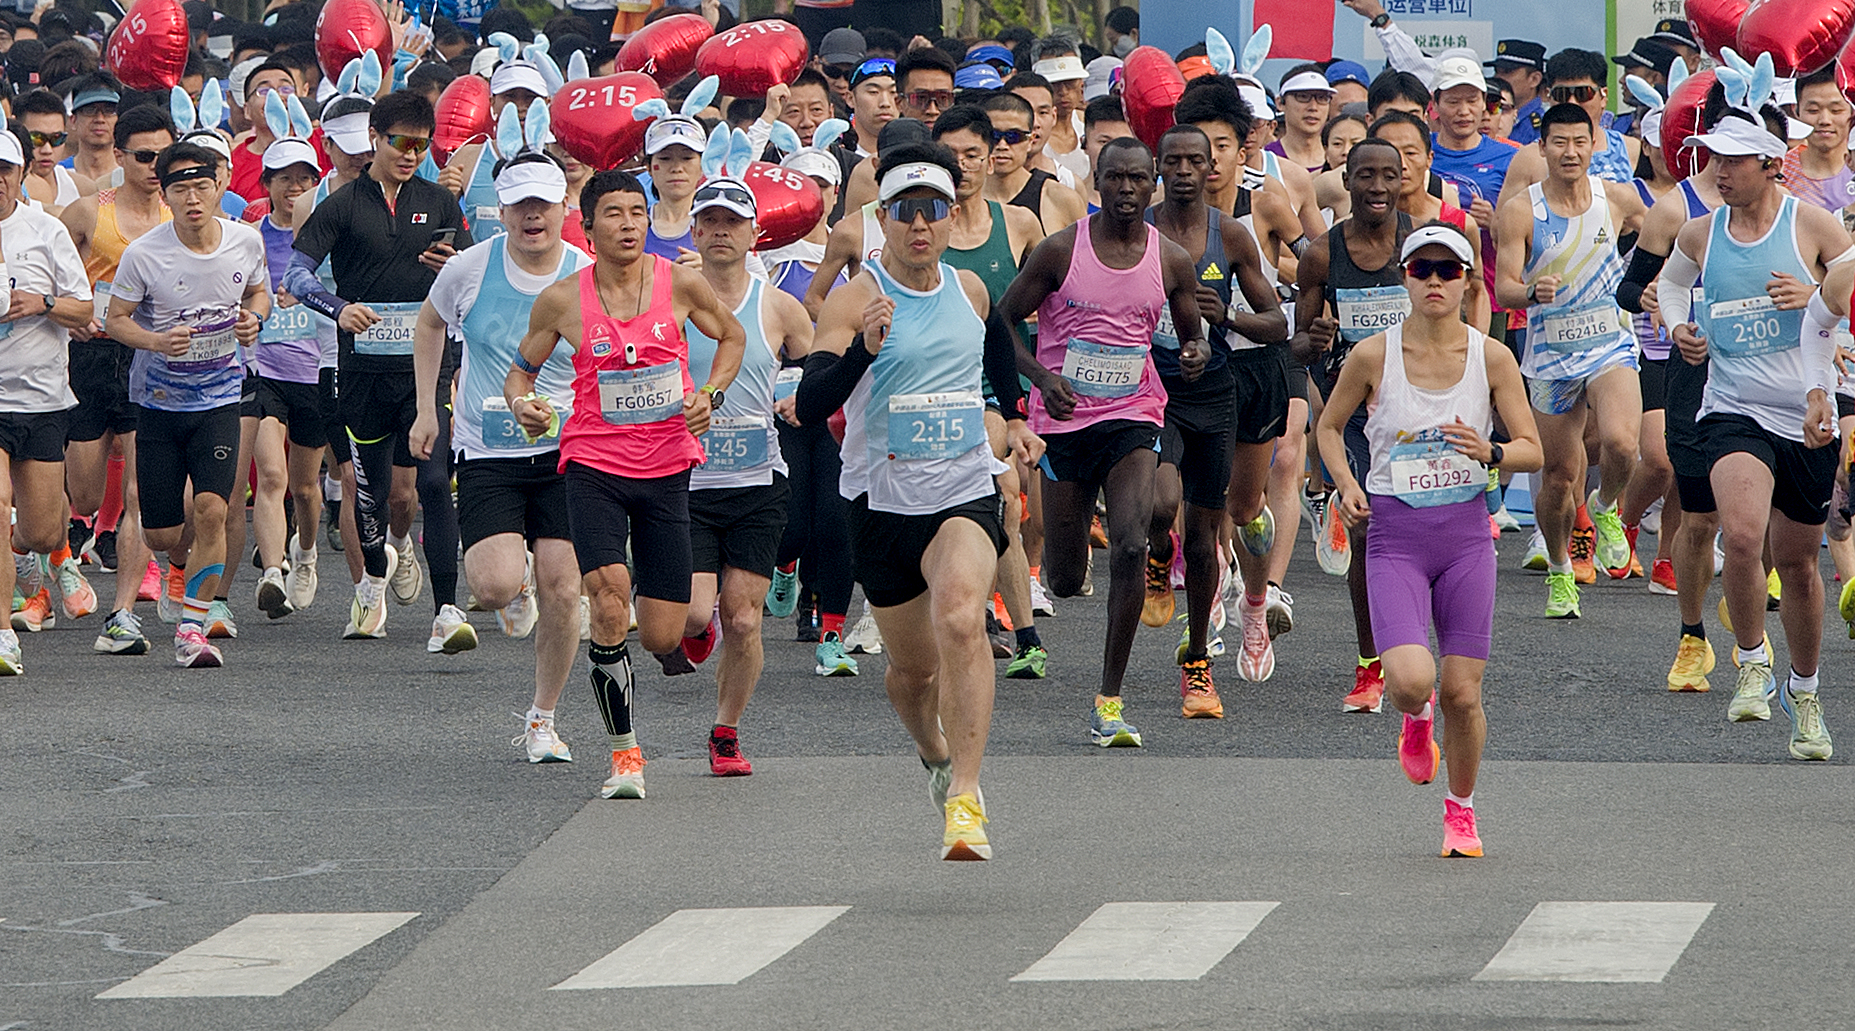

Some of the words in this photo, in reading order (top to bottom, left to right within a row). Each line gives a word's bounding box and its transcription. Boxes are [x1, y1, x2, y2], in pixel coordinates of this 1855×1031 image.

[110, 12, 147, 68] 2:15
[721, 22, 786, 48] 2:15
[568, 85, 637, 111] 2:15
[752, 165, 804, 191] :45
[268, 311, 309, 330] 3:10
[1351, 311, 1406, 327] FG2680
[1557, 321, 1608, 341] FG2416
[1732, 317, 1781, 344] 2:00
[191, 349, 220, 361] TK039
[1075, 366, 1131, 384] FG1775
[615, 389, 673, 410] FG0657
[911, 417, 965, 443] 2:15
[701, 437, 748, 458] 1:45
[1409, 469, 1472, 491] FG1292
